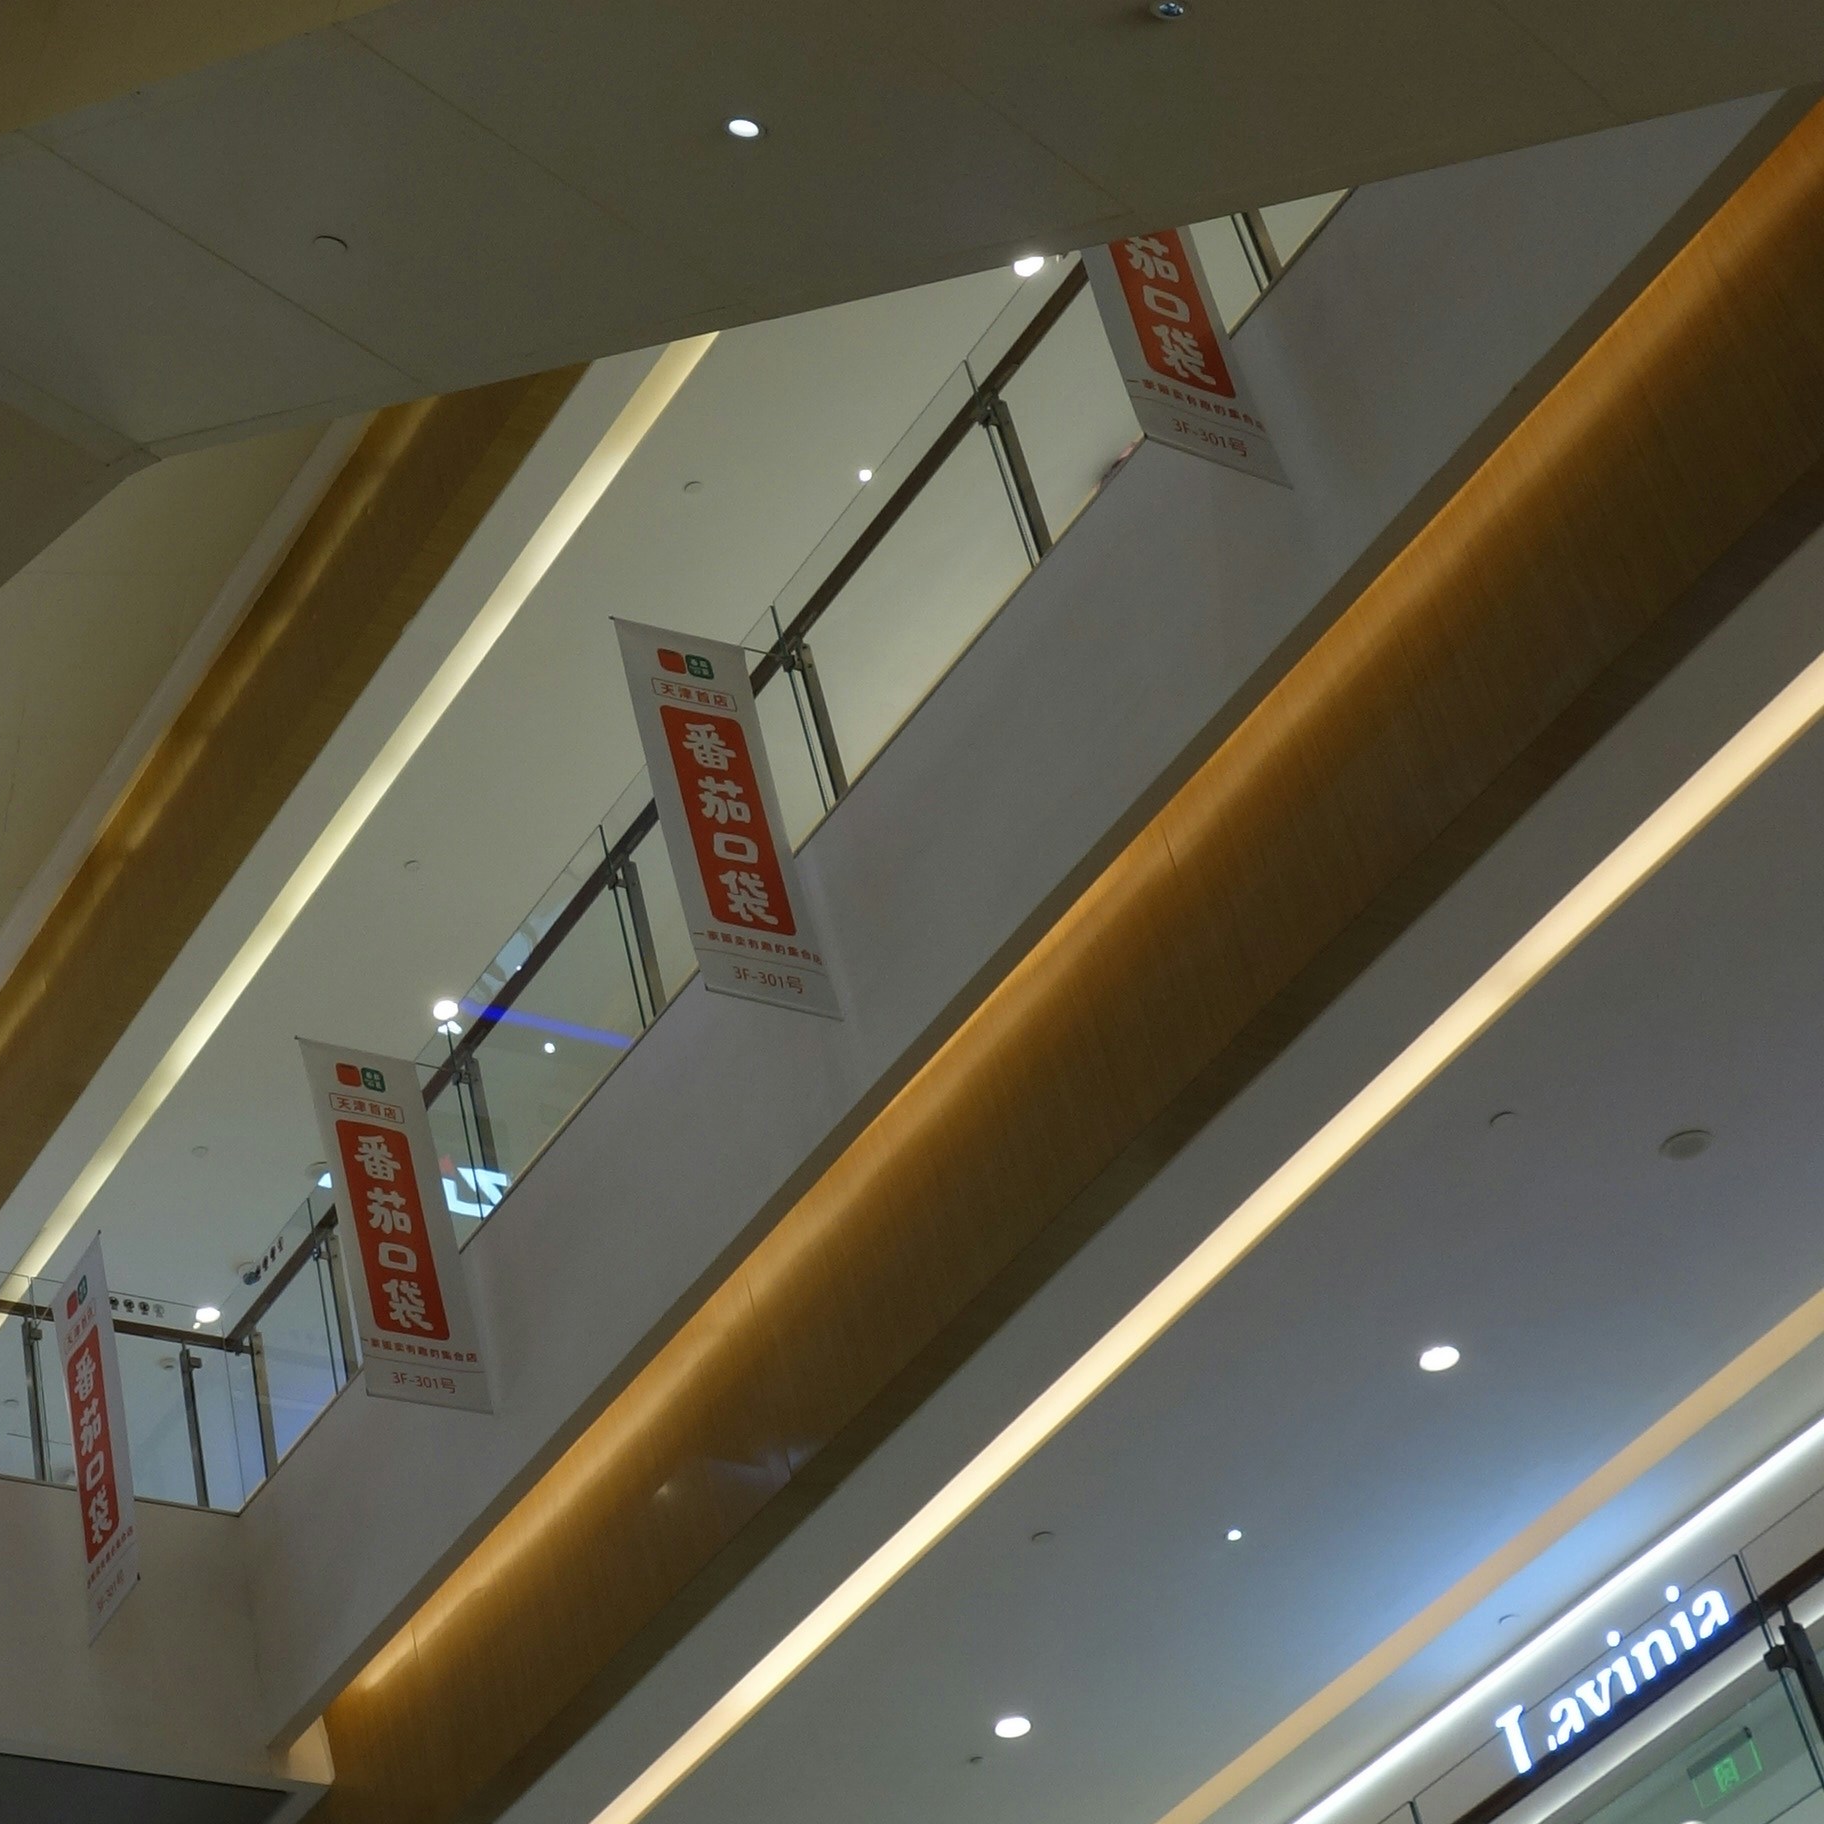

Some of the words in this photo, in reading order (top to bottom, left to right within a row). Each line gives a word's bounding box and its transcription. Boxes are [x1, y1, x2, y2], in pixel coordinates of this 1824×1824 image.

[1171, 417, 1248, 459] 3F-301号
[660, 682, 729, 708] 天津首店
[681, 721, 781, 927] 番茄口袋
[732, 965, 805, 995] 3F-301号
[336, 1096, 397, 1121] 天津首店
[353, 1132, 434, 1333] 番茄口袋
[391, 1370, 457, 1395] 3F-301号
[73, 1345, 113, 1546] 番茄口袋
[1494, 1584, 1732, 1775] Lavinia
